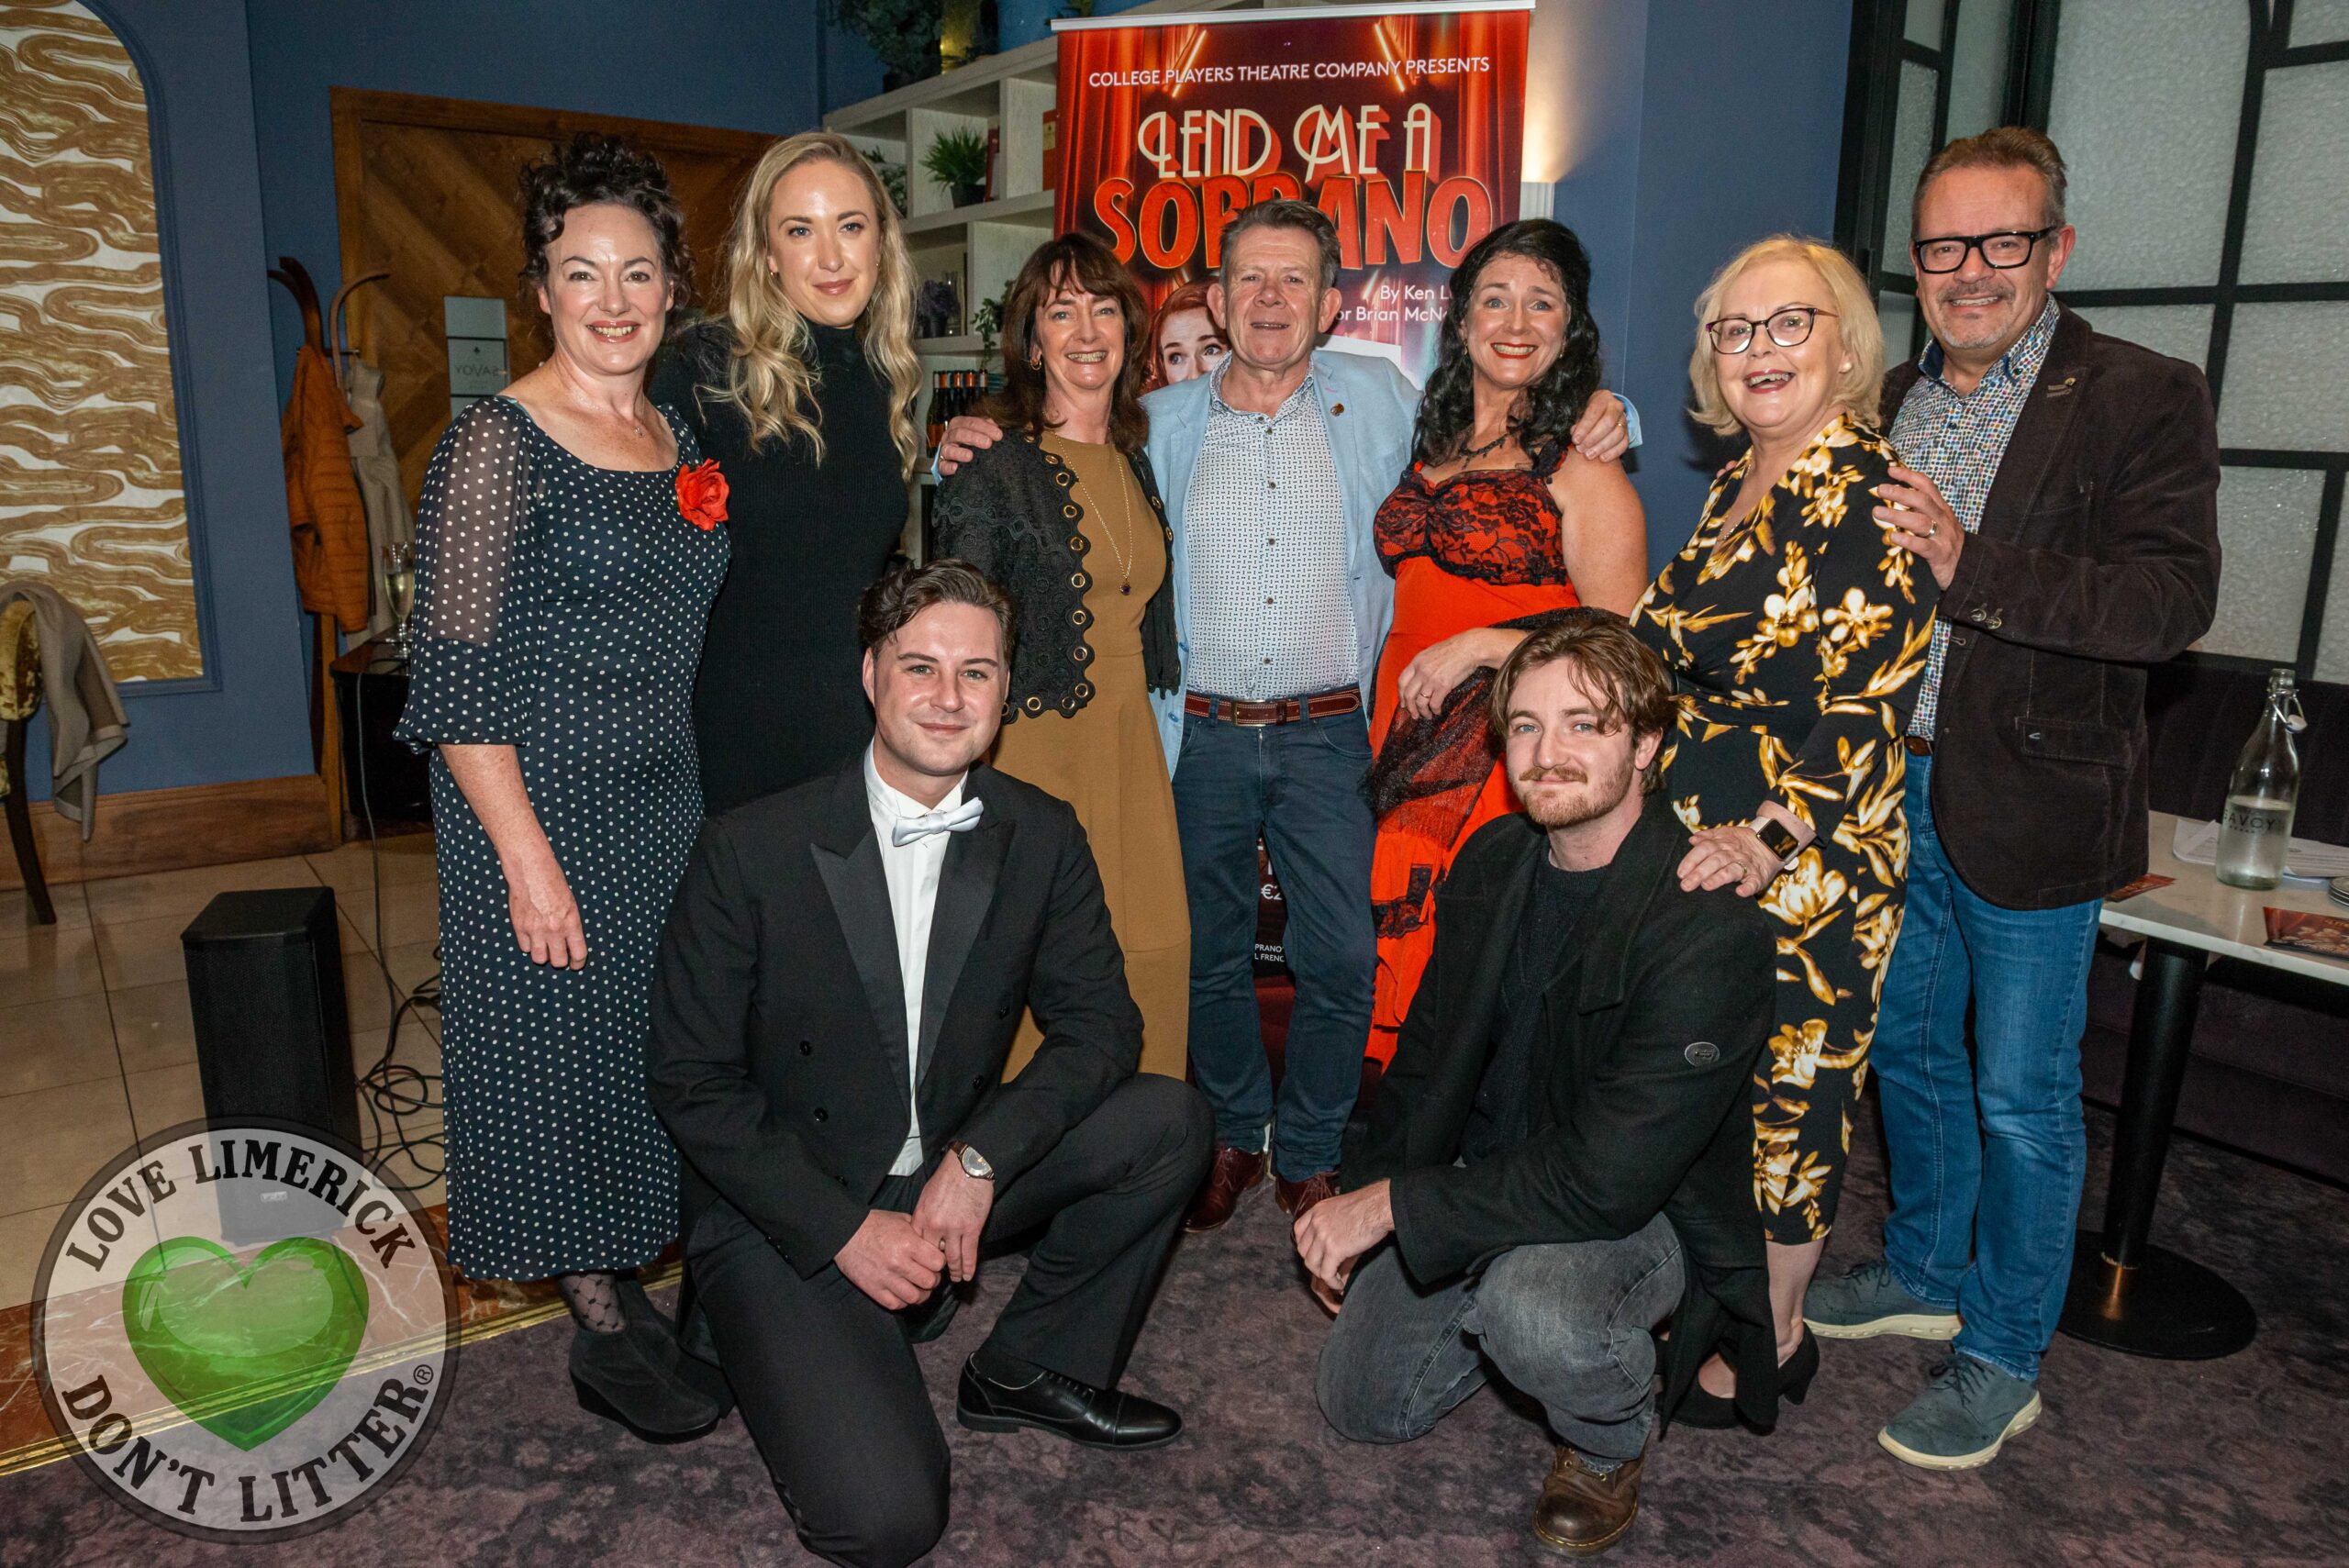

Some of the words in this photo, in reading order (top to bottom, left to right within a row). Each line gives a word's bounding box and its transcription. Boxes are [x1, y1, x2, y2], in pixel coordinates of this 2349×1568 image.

[1089, 70, 1160, 87] COLLEGE
[1165, 67, 1234, 83] PLAYERS
[1238, 63, 1310, 81] THEATRE
[1314, 61, 1401, 78] COMPANY
[1406, 56, 1490, 75] PRESENTS
[1138, 108, 1274, 178] LEND
[1293, 104, 1382, 183] ME
[1403, 103, 1433, 172] A
[1380, 284, 1399, 305] By
[1405, 284, 1434, 300] Ken
[1356, 306, 1398, 321] Brian
[2224, 808, 2276, 830] SAVOY
